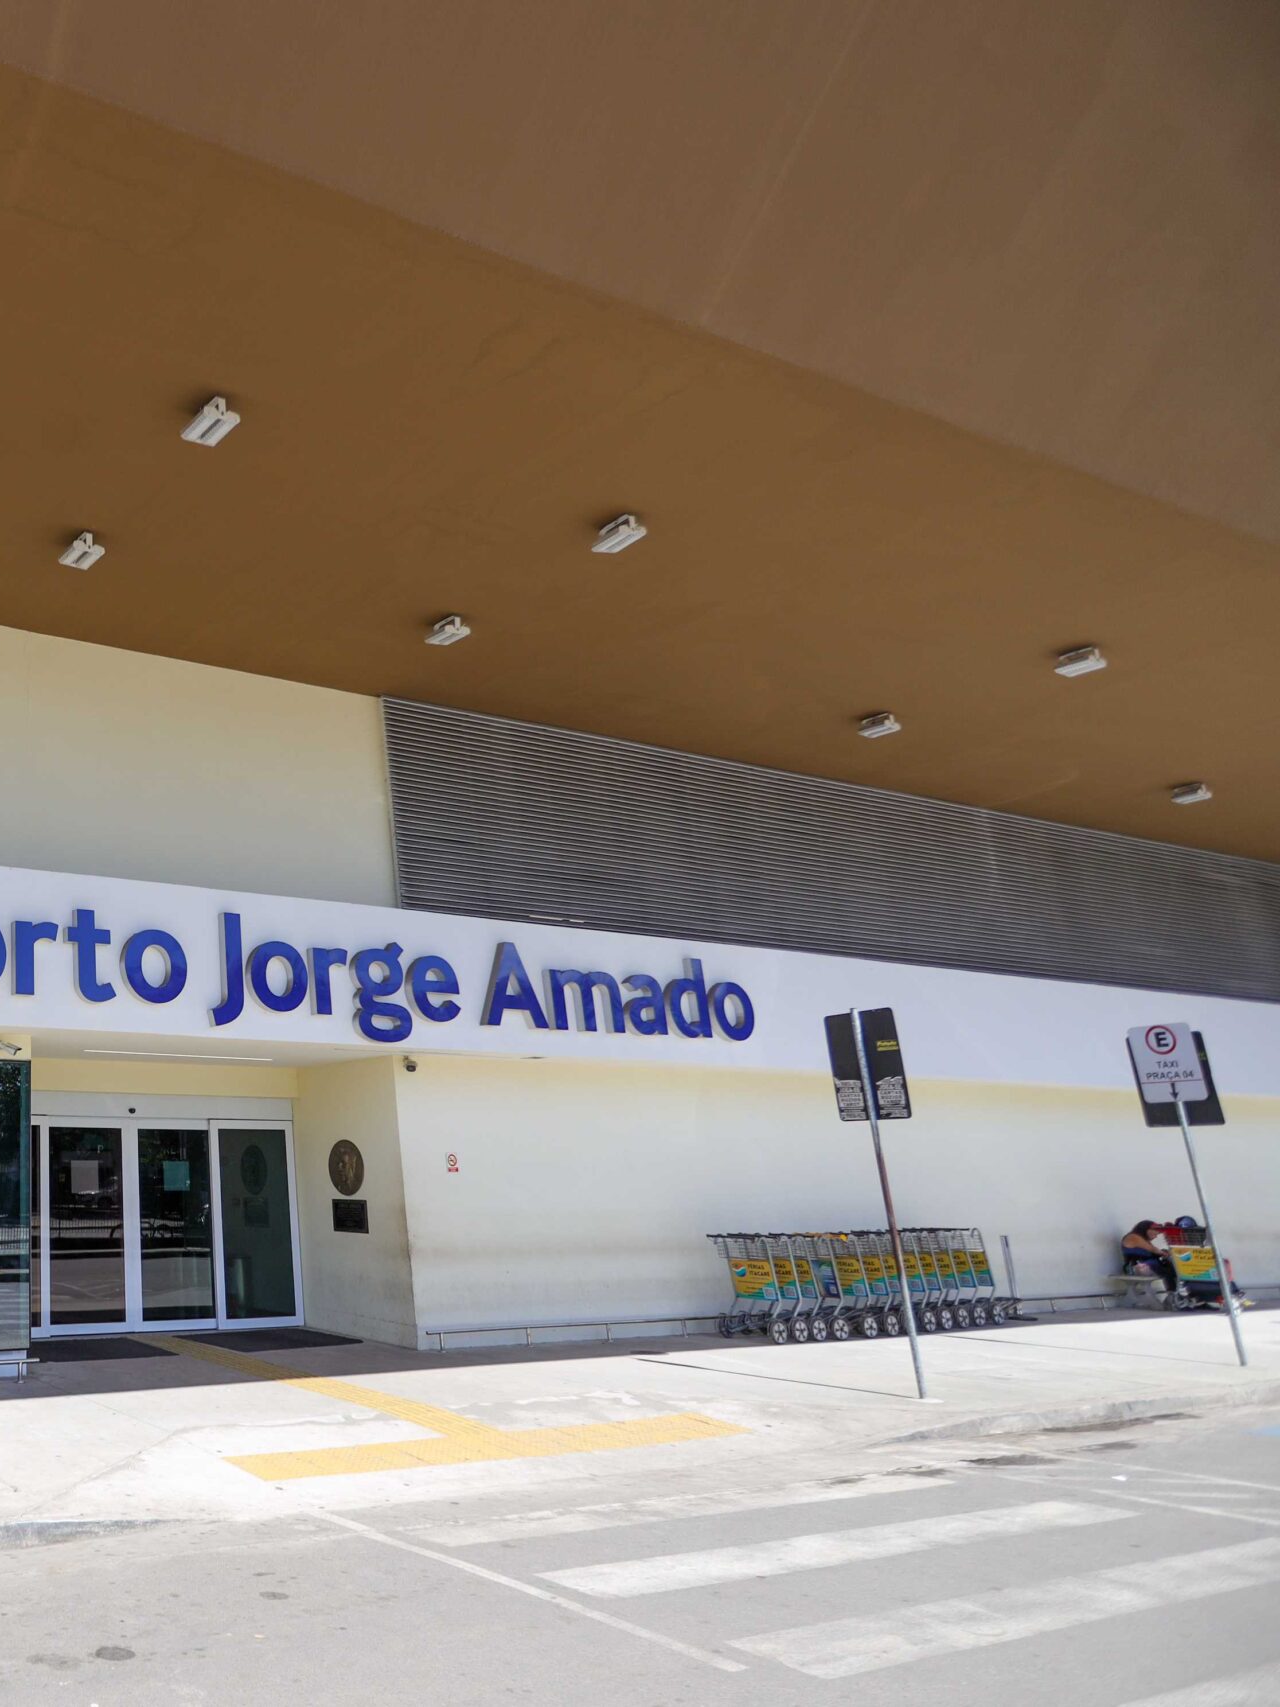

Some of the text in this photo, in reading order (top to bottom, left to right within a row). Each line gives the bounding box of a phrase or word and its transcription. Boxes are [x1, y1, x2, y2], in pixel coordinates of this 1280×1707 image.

[207, 911, 462, 1043] Jorge
[479, 941, 755, 1042] Amado
[1154, 1031, 1169, 1048] E
[1146, 1070, 1195, 1080] PRAÇA 04
